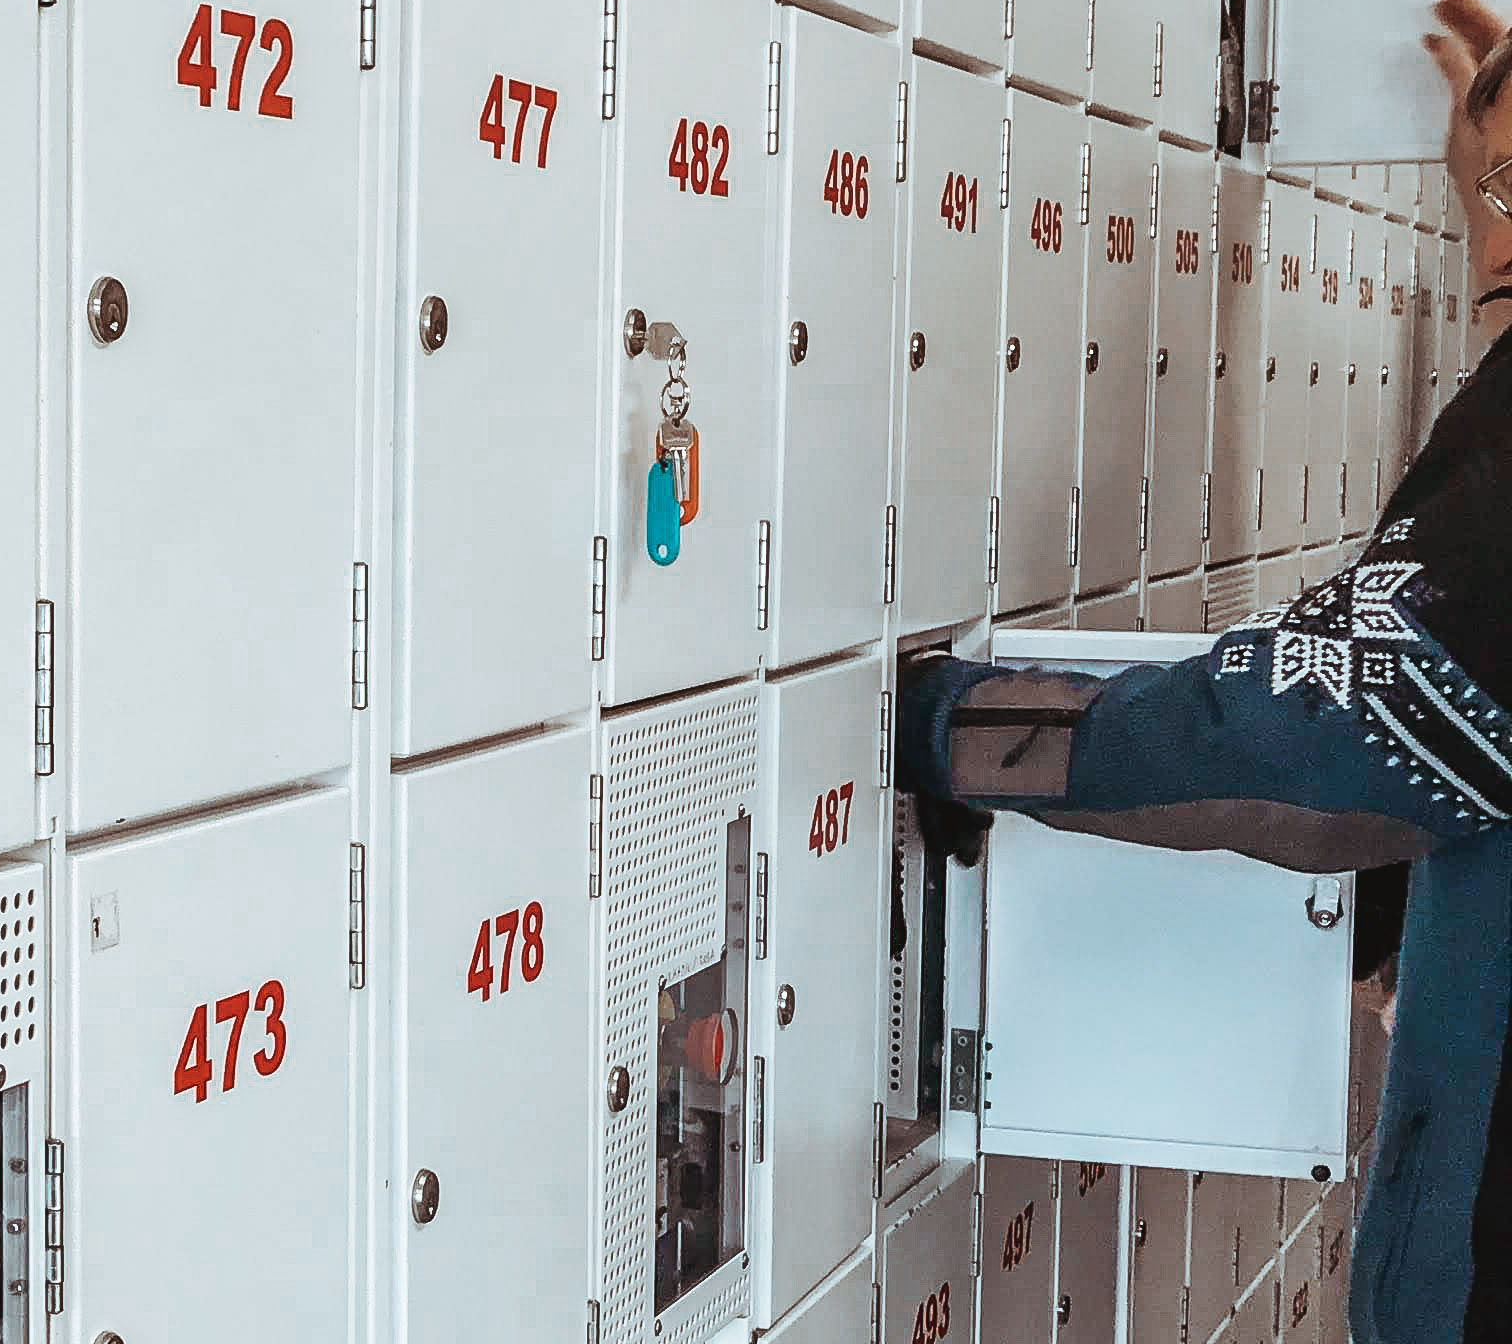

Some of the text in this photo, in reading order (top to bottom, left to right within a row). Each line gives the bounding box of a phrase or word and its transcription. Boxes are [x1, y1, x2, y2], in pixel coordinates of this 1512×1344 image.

[178, 4, 293, 119] 472
[480, 74, 557, 168] 477
[669, 119, 729, 197] 482
[824, 150, 868, 219] 486
[941, 172, 977, 233] 491
[1031, 198, 1062, 253] 496
[1107, 216, 1134, 264] 500
[1176, 230, 1198, 274] 505
[1232, 243, 1252, 284] 510
[1281, 254, 1299, 292] 514
[809, 781, 853, 857] 487
[468, 902, 543, 1002] 478
[174, 980, 286, 1103] 473
[1003, 1201, 1034, 1271] 497
